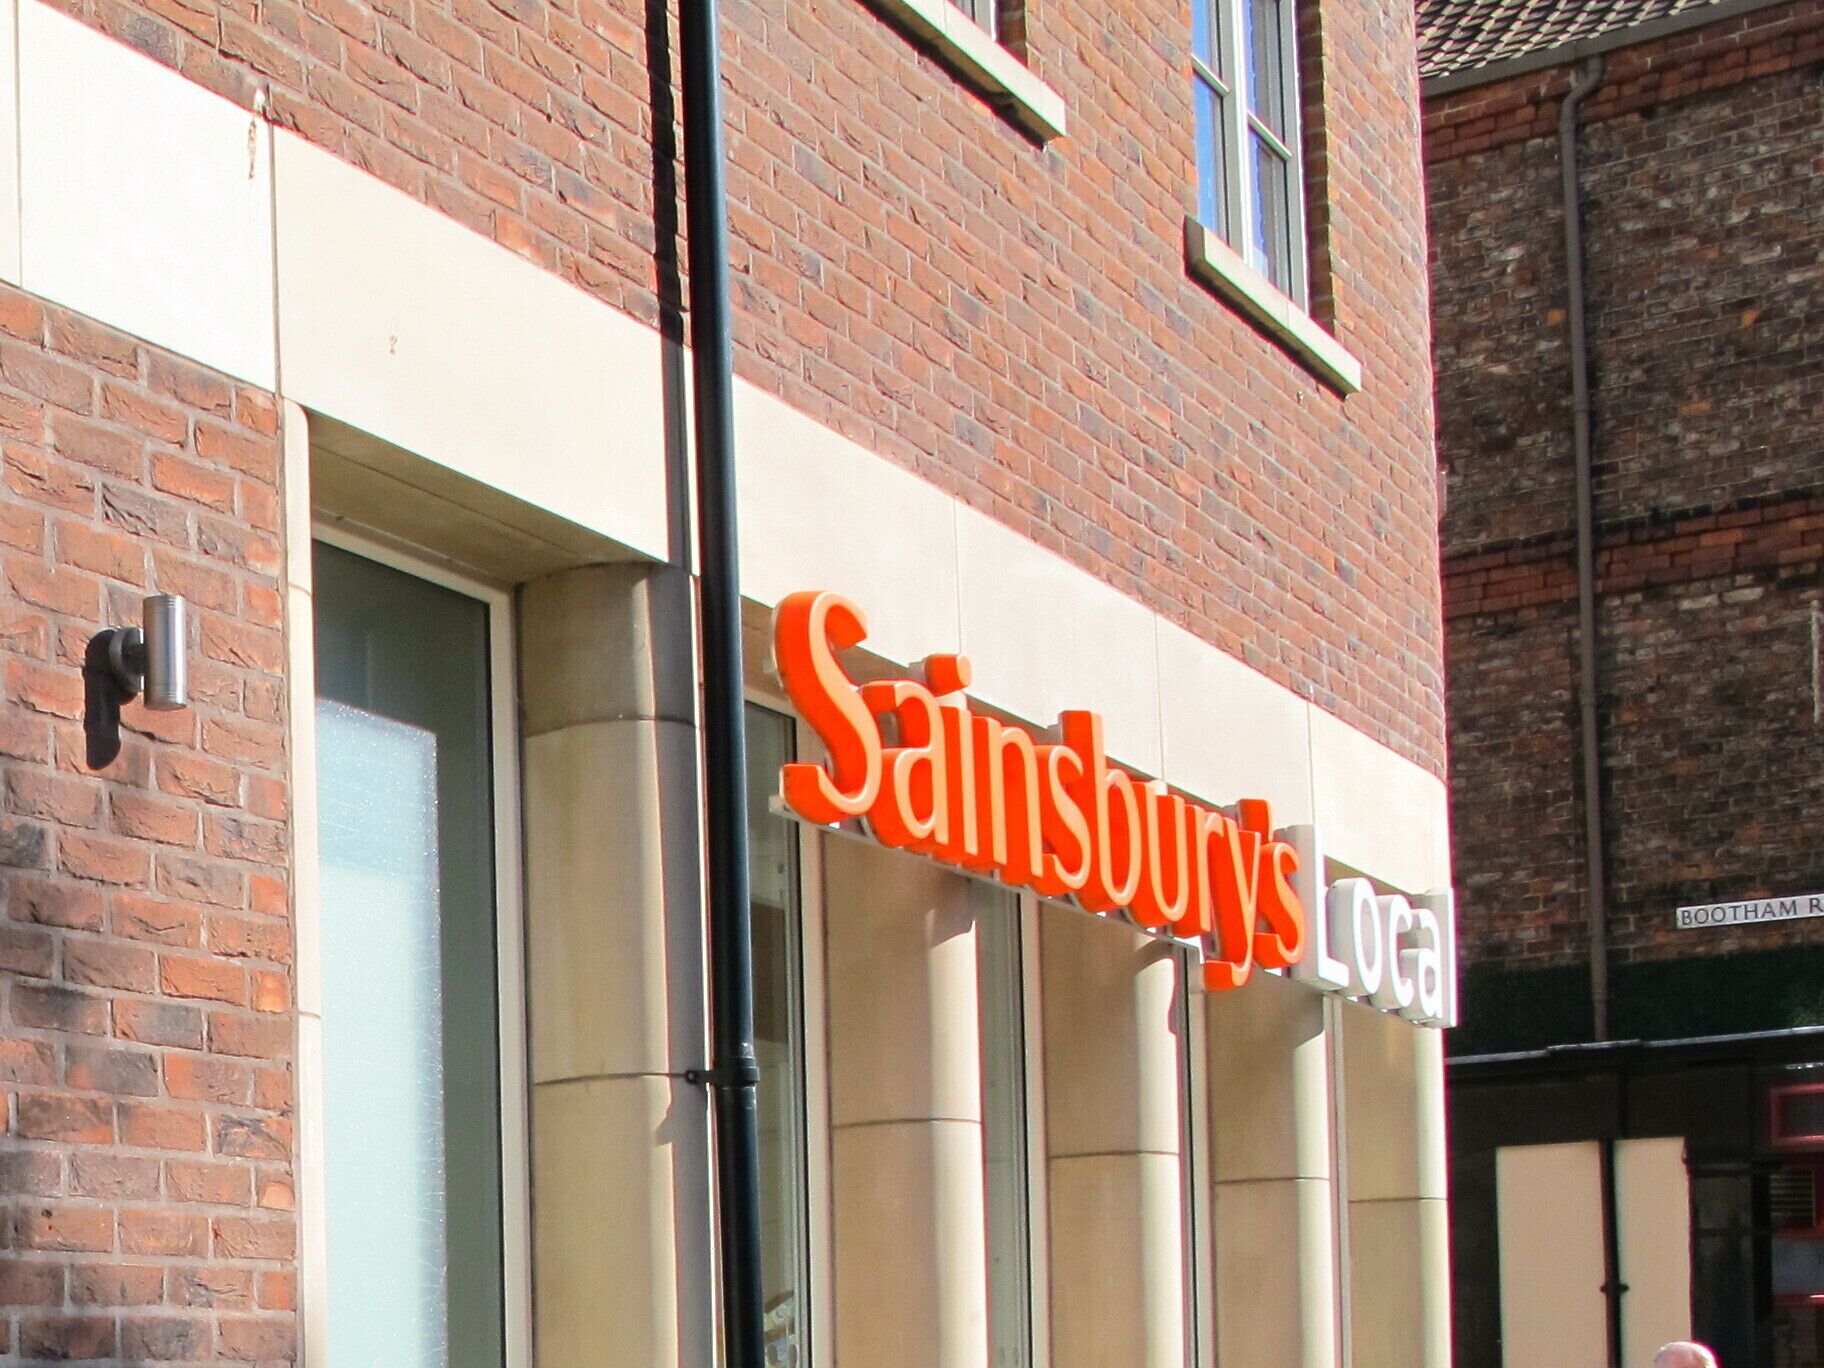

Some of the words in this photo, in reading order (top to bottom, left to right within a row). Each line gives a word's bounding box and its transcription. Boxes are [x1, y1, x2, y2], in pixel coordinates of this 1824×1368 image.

[773, 590, 1307, 991] Sainsbury's
[1290, 824, 1457, 1028] Local
[1681, 898, 1798, 926] BOOTHAM
